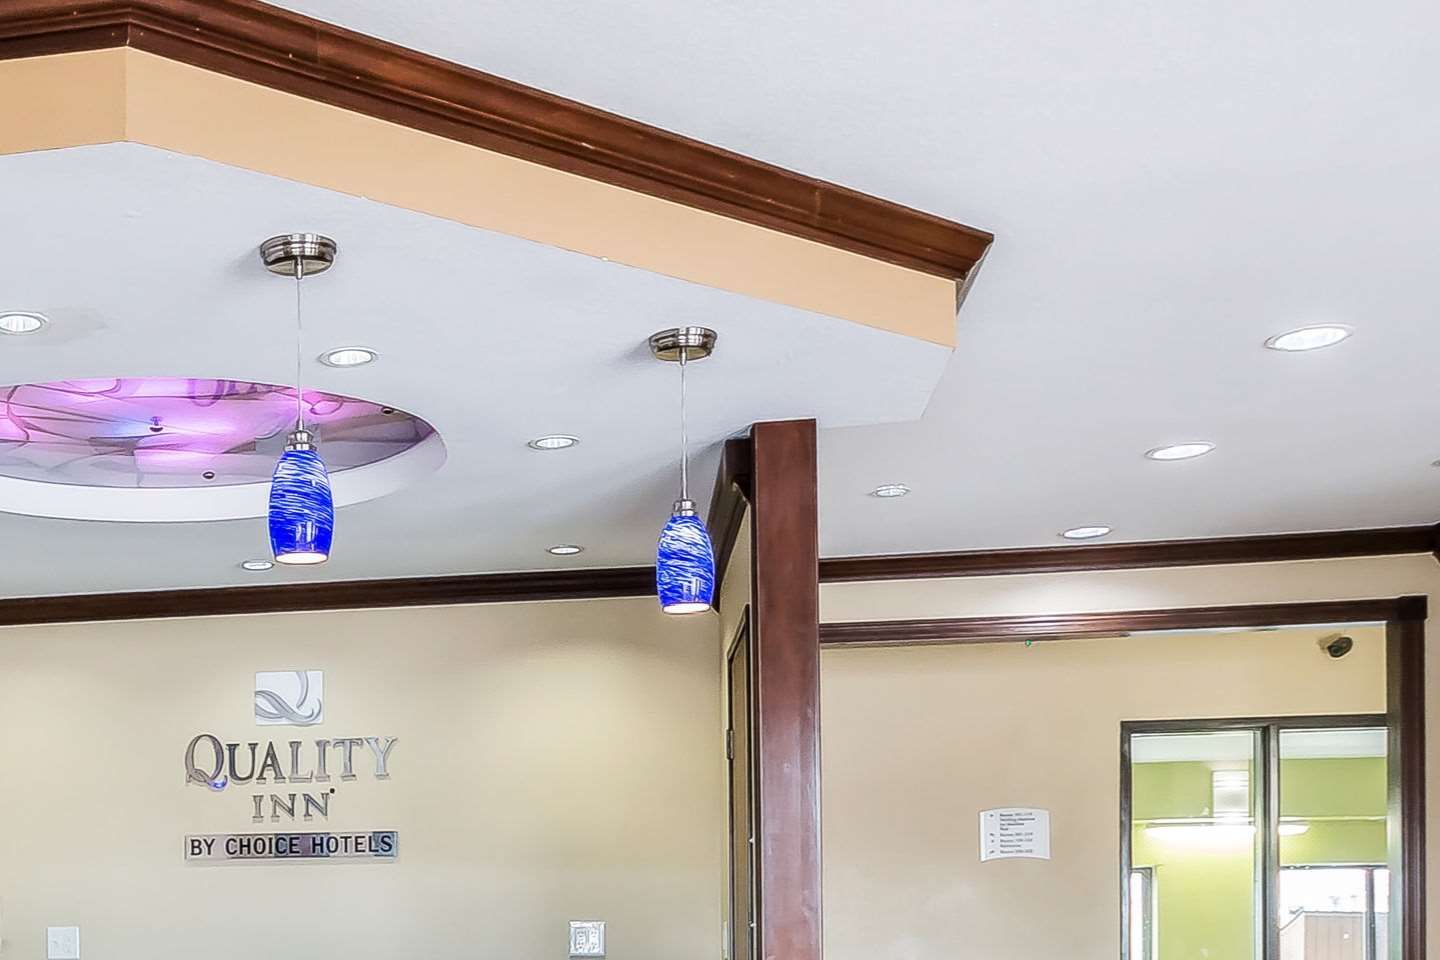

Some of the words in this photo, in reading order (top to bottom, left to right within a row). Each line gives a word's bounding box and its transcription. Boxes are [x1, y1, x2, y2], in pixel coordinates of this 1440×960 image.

[184, 733, 399, 791] QUALITY
[252, 792, 331, 823] INN
[189, 838, 216, 856] BY
[225, 835, 301, 856] CHOICE
[311, 834, 393, 854] HOTELS
